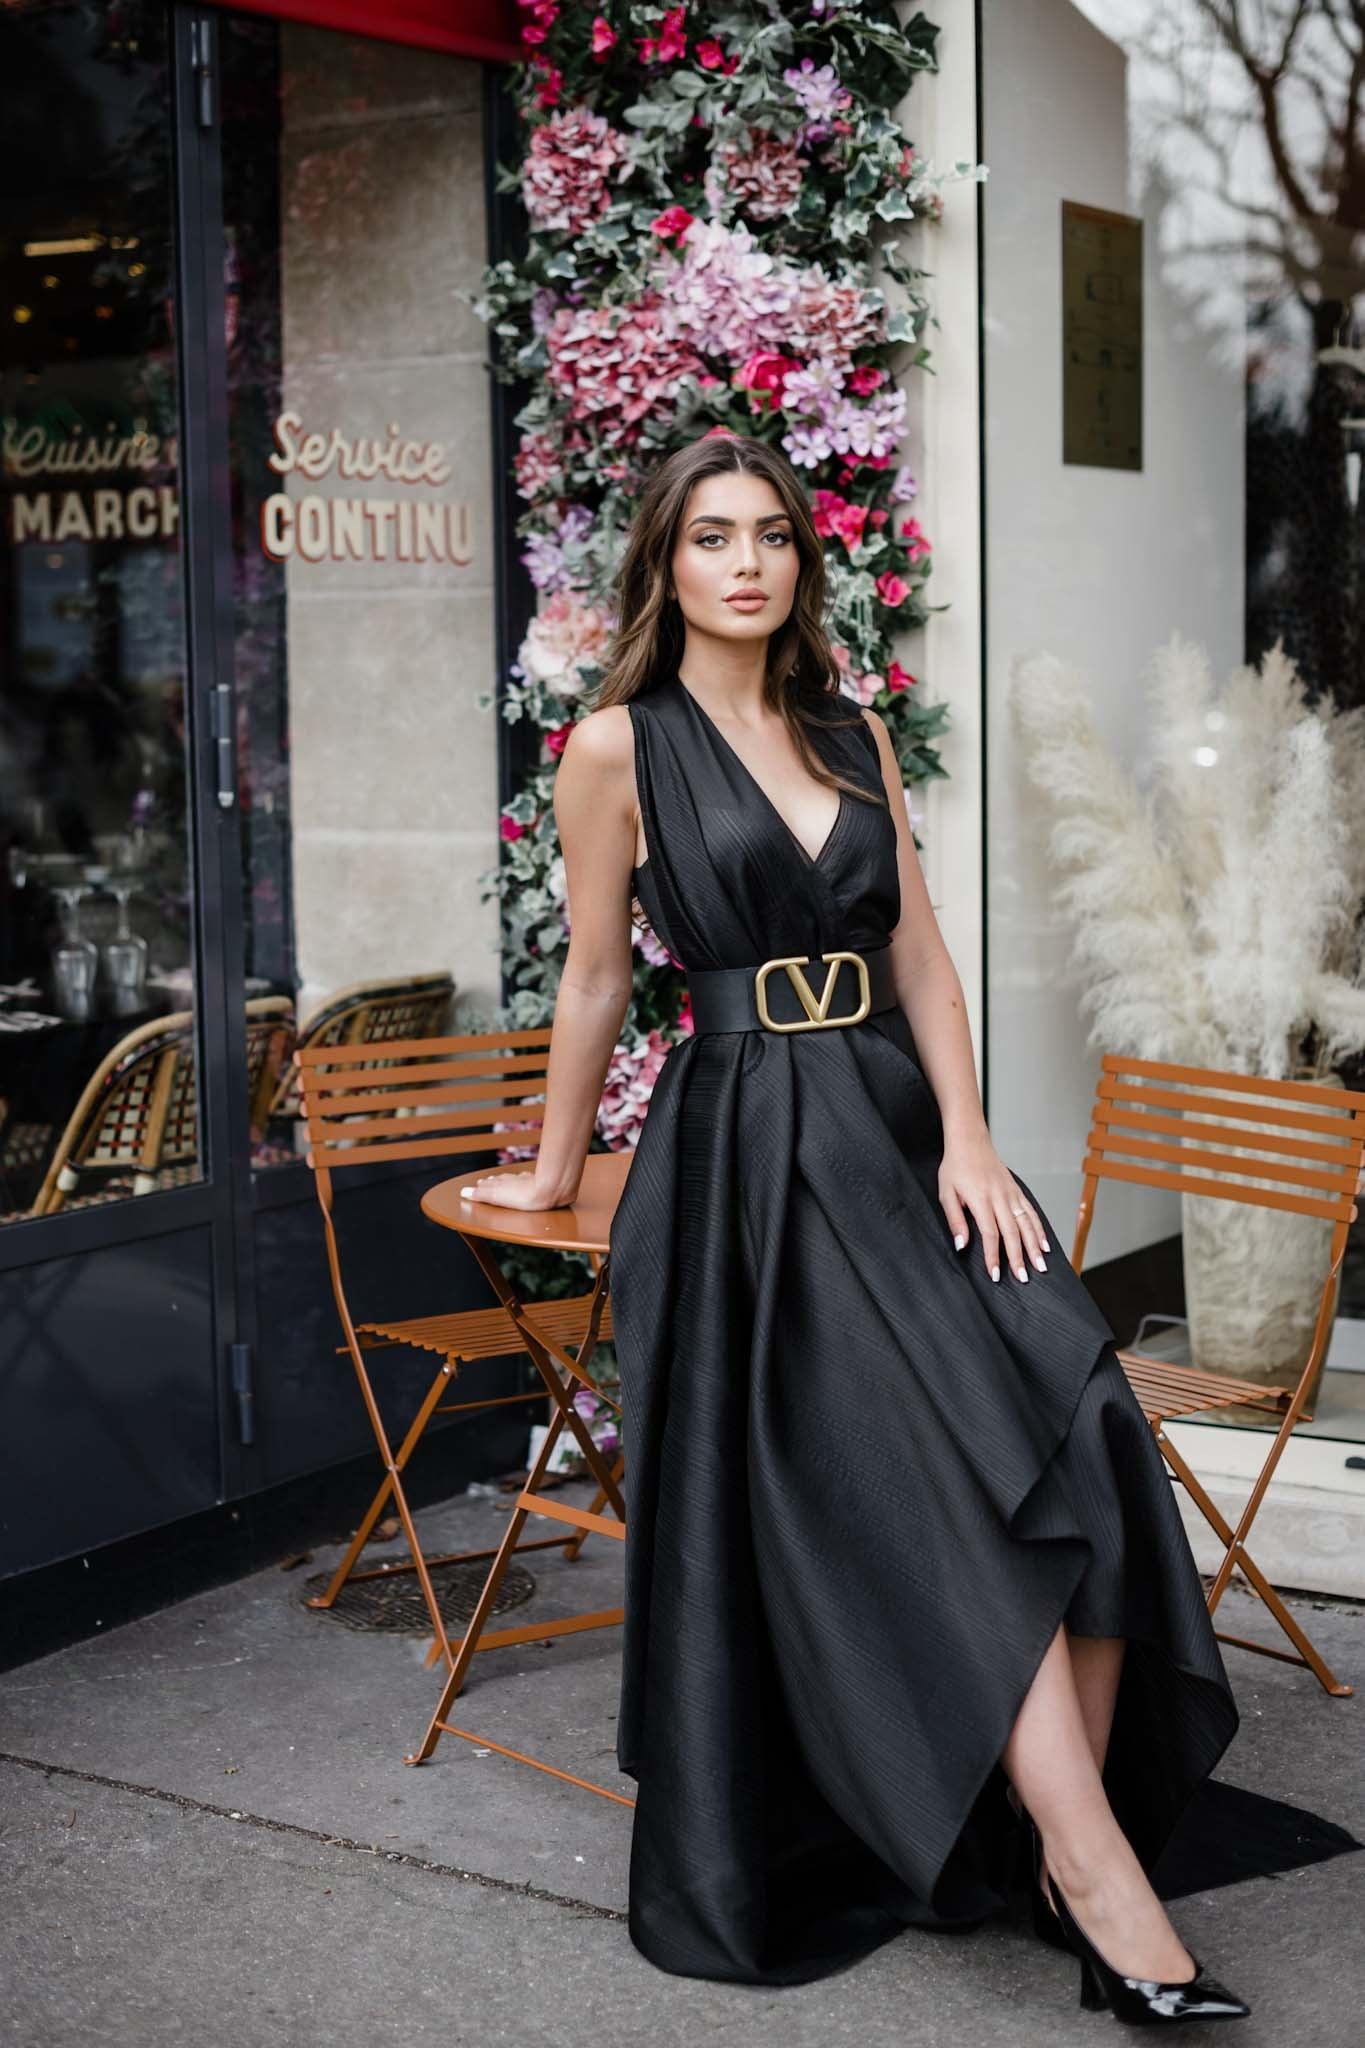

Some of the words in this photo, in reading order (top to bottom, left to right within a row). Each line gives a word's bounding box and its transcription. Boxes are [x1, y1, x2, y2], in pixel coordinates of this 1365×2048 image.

[3, 417, 160, 477] Cuisine
[268, 411, 451, 487] Service
[260, 492, 473, 567] CONTINU
[775, 952, 851, 1026] V
